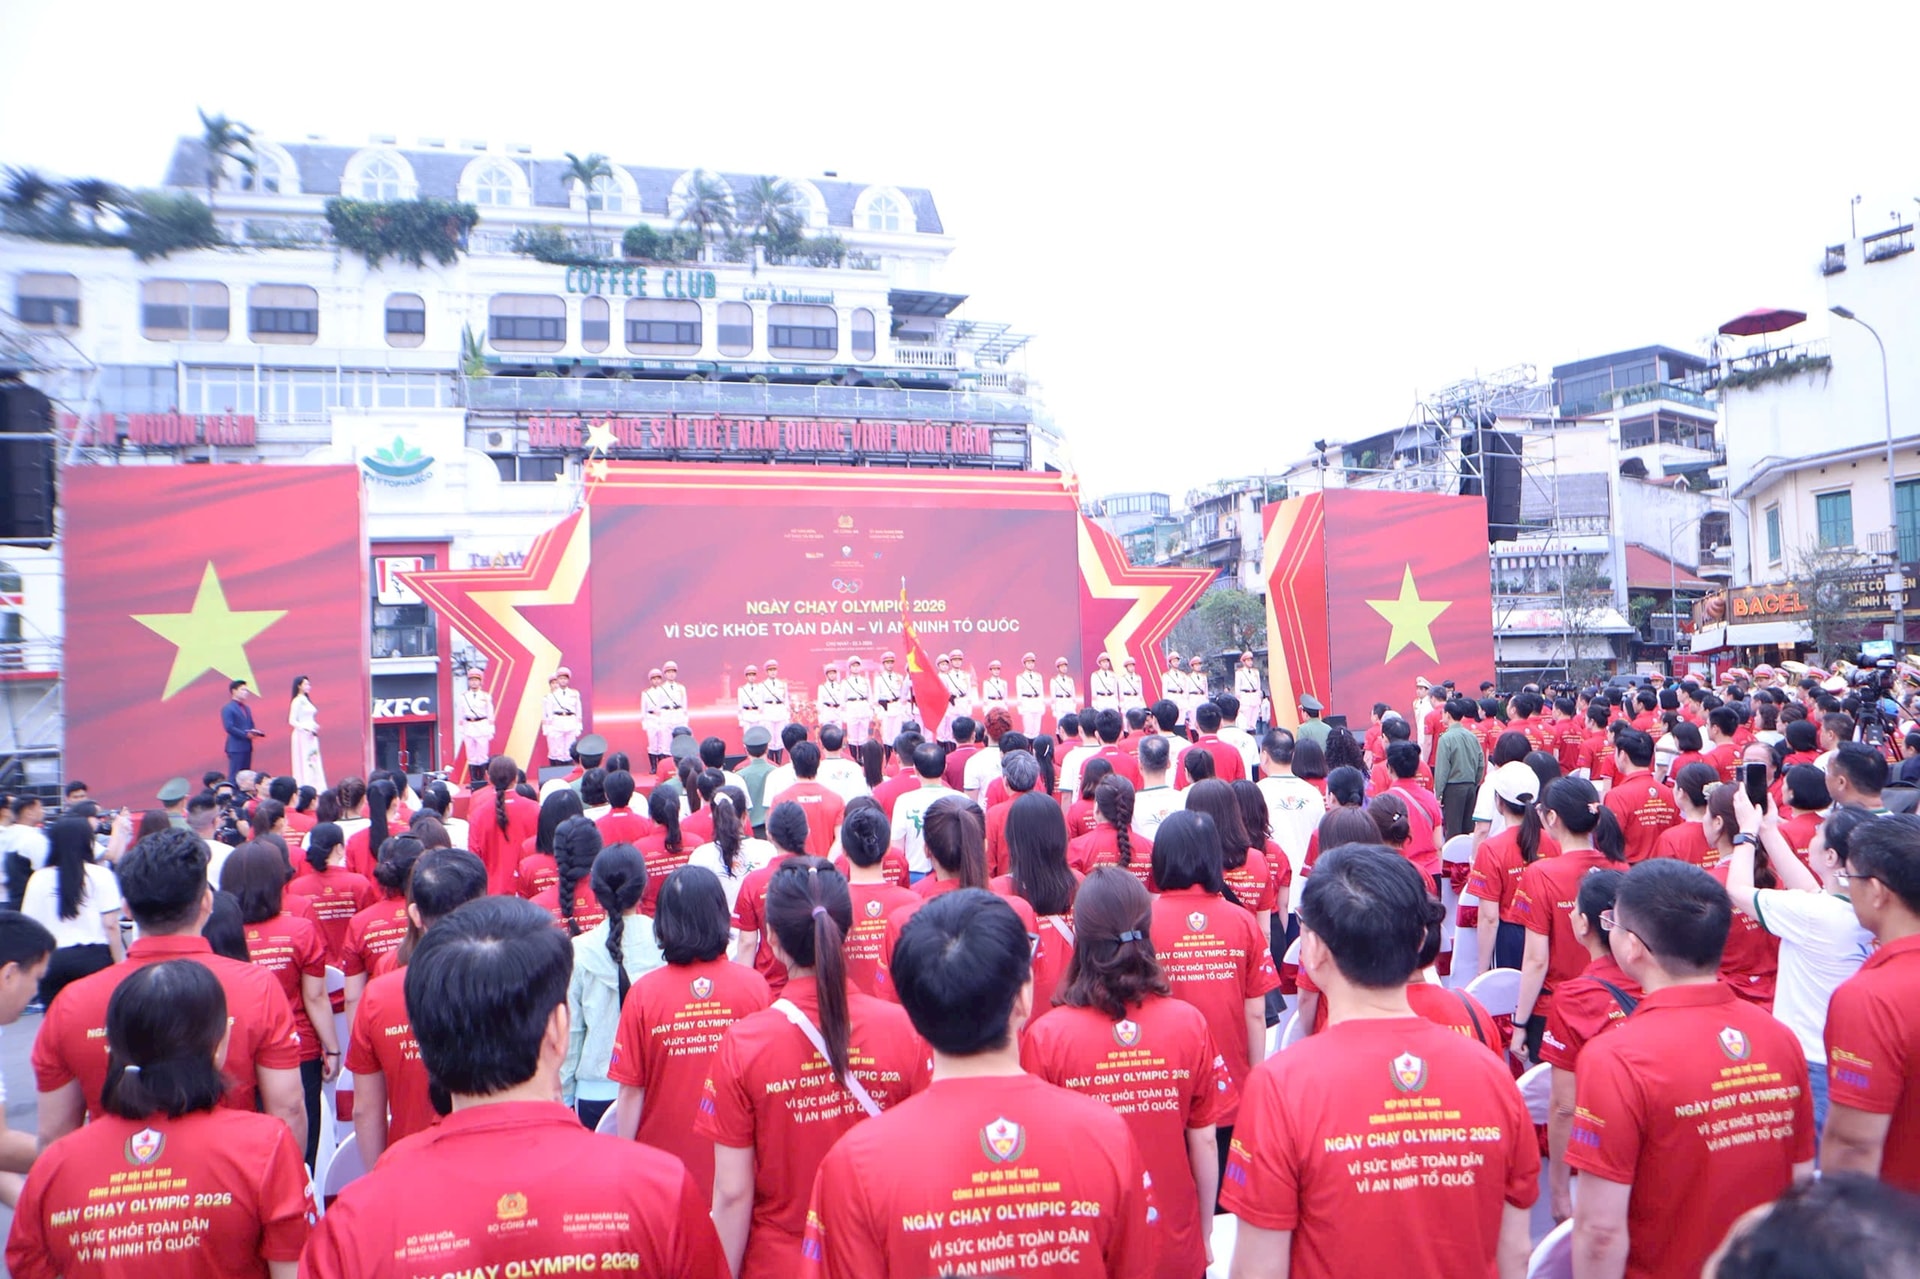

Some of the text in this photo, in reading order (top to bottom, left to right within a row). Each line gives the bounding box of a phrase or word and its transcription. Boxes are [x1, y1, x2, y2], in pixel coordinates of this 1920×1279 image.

[565, 265, 716, 298] COFFEE CLUB
[128, 405, 196, 445] MUÔN
[205, 406, 255, 446] NĂM
[590, 410, 642, 452] NG
[650, 409, 688, 447] SẢN
[693, 412, 733, 453] VIỆT
[738, 419, 780, 450] NAM
[784, 421, 845, 452] QUANG
[852, 423, 891, 452] VINH
[896, 418, 946, 453] MUÔN
[951, 419, 990, 455] NĂM
[746, 598, 946, 616] NGÀY CHẠY OLYMPIC 2026
[1733, 592, 1808, 617] BAGEL
[664, 622, 679, 638] VÌ
[772, 620, 816, 636] TOÀN
[821, 619, 853, 635] DÂN
[869, 619, 883, 634] VÌ
[887, 621, 904, 633] AN
[912, 620, 949, 633] NINH
[952, 617, 973, 632] TỔ
[977, 617, 1020, 632] QUỐC
[372, 696, 430, 718] KFC
[1155, 949, 1244, 960] GÀY CHẠY OLYMPIC 2026
[1188, 973, 1204, 981] NINH
[1216, 971, 1234, 979] QUỐC
[385, 1023, 409, 1037] NGÀY
[673, 1019, 734, 1031] CHẠY OLYMPIC
[686, 1033, 706, 1043] KHỎE
[675, 1047, 686, 1055] AN
[688, 1046, 707, 1054] NINH
[766, 1074, 825, 1093] NGÀY CHẠY
[1066, 1070, 1168, 1088] NGÀY CHẠY OLYMPIC
[786, 1096, 817, 1109] VÌ SỨC
[1112, 1088, 1162, 1102] KHỎE TOÀN
[1137, 1099, 1179, 1112] TỔ QUỐC
[794, 1102, 854, 1123] VÌ AN TỔ
[1675, 1100, 1710, 1118] NGÀY
[1324, 1127, 1500, 1152] NGÀY CHẠY OLYMPIC 2026
[1348, 1152, 1457, 1176] VÌ SỨC KHỎE TOÀN
[1356, 1169, 1439, 1193] VÌ AN NINH TỔ
[51, 1192, 232, 1227] NGÀY CHẠY OLYMPIC 2026
[902, 1202, 1065, 1232] NGÀY CHẠY OLYMPIC
[81, 1216, 209, 1244] SỨC KHỎE TOÀN DÂN
[500, 1219, 525, 1231] CÔNG
[526, 1218, 538, 1227] AN
[77, 1232, 200, 1262] VÌ NINH TỔ QUỐC
[929, 1227, 1089, 1259] VÌ SỨC KHỎE TOÀN DÂN
[505, 1252, 639, 1278] OLYMPIC 2026
[938, 1246, 1080, 1277] VÌ AN NINH TỔ QUỐC
